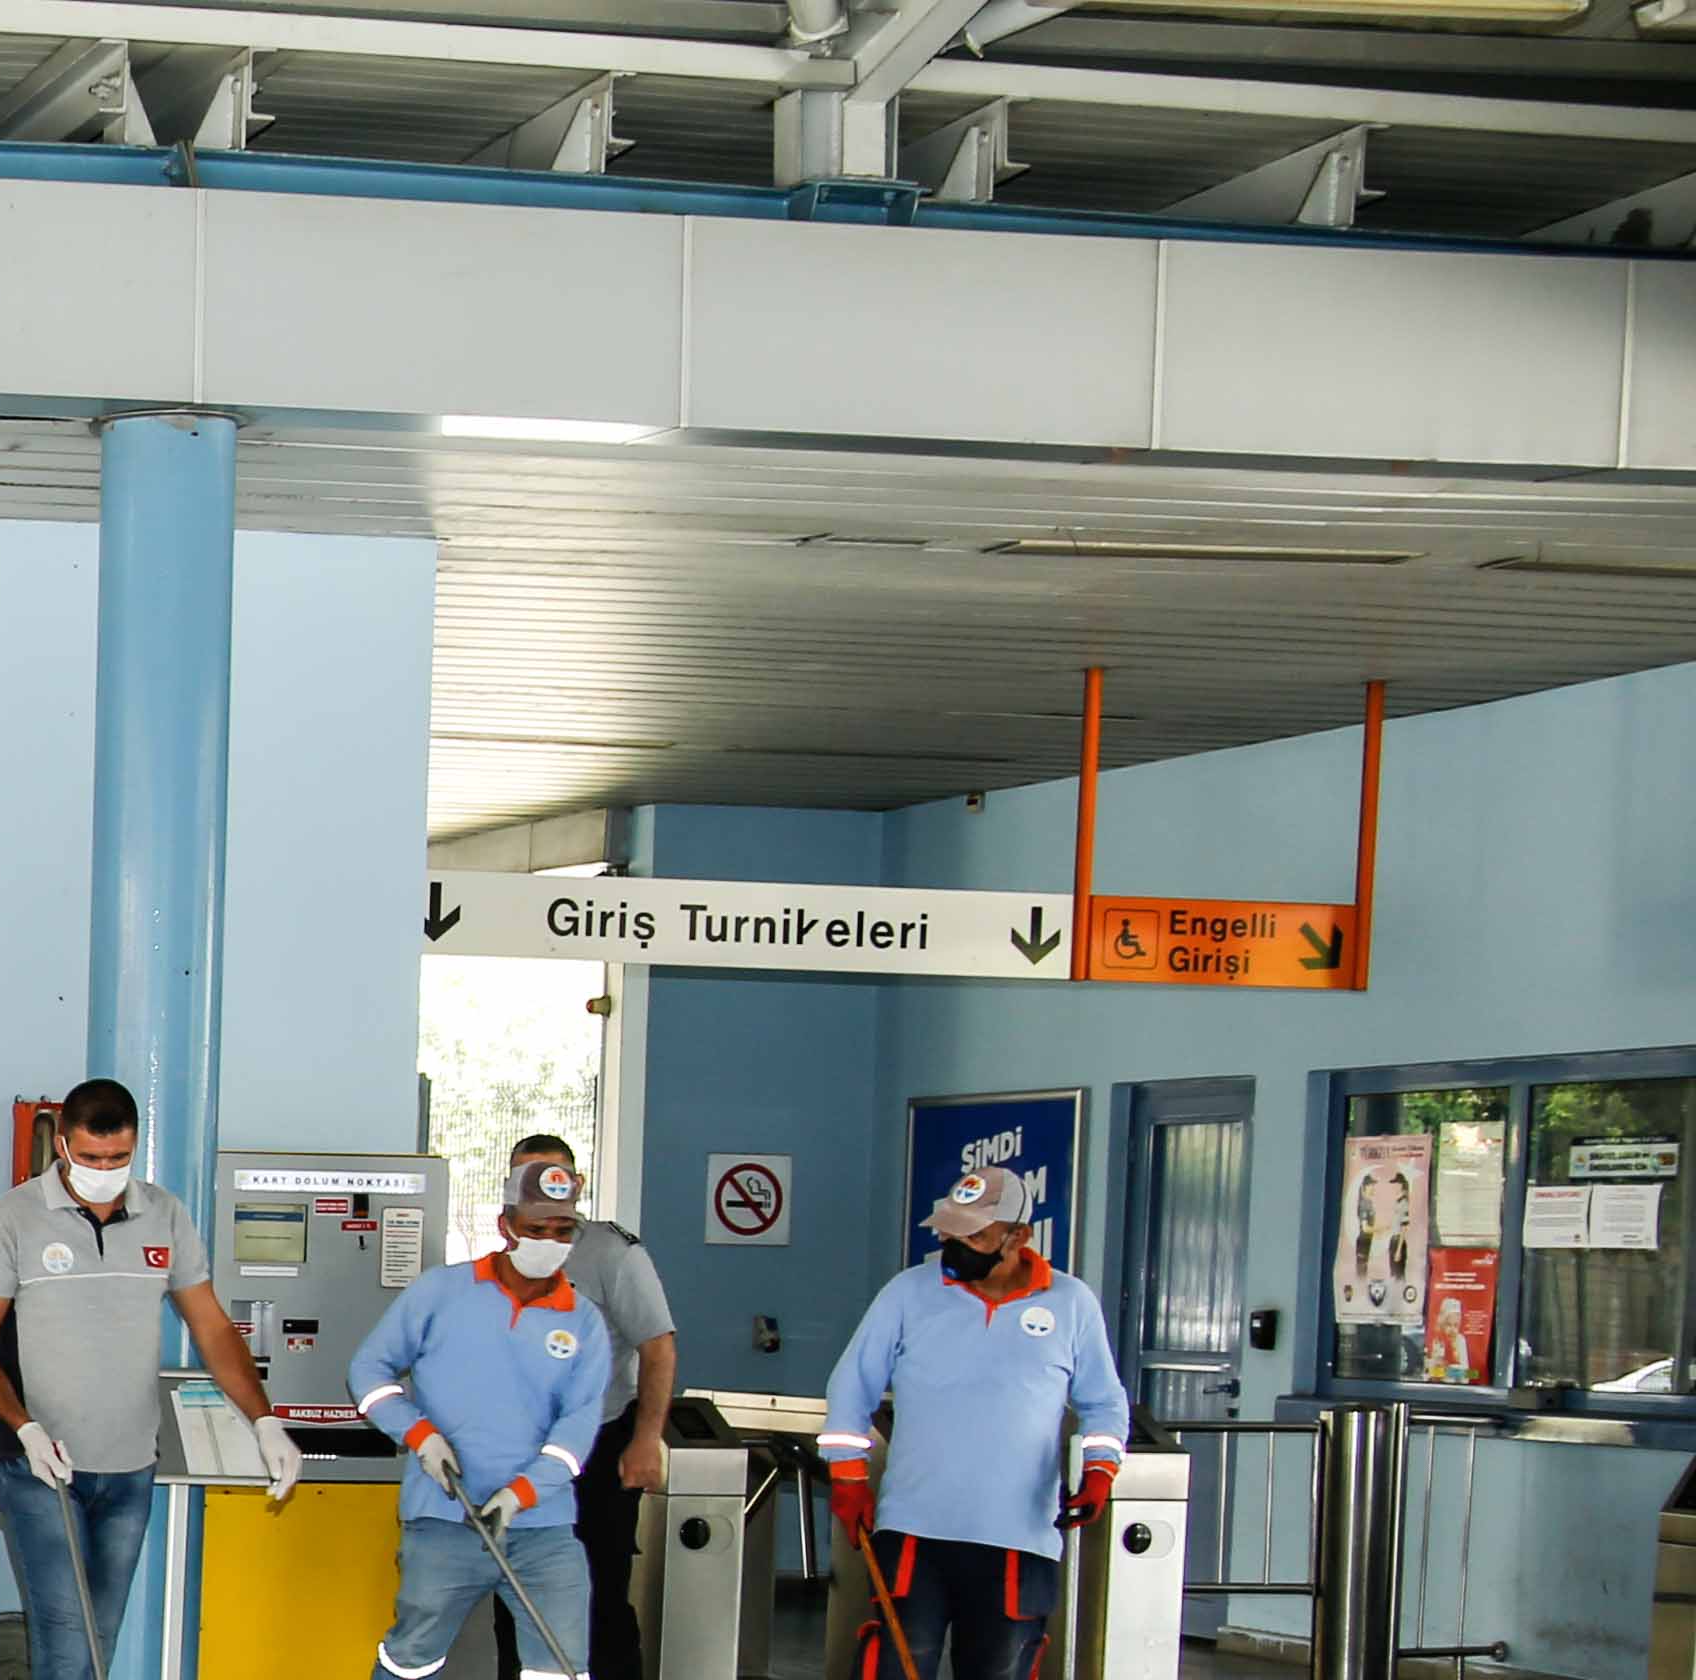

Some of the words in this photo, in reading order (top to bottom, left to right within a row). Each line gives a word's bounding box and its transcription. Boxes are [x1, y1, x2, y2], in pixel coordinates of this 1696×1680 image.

[547, 898, 655, 949] Giriş
[679, 904, 929, 949] Turnikeleri
[1169, 909, 1276, 942] Engelli
[1168, 946, 1251, 980] Girişi
[253, 1175, 287, 1184] KART
[295, 1176, 340, 1185] DOLUM
[347, 1178, 406, 1187] NOKTASI
